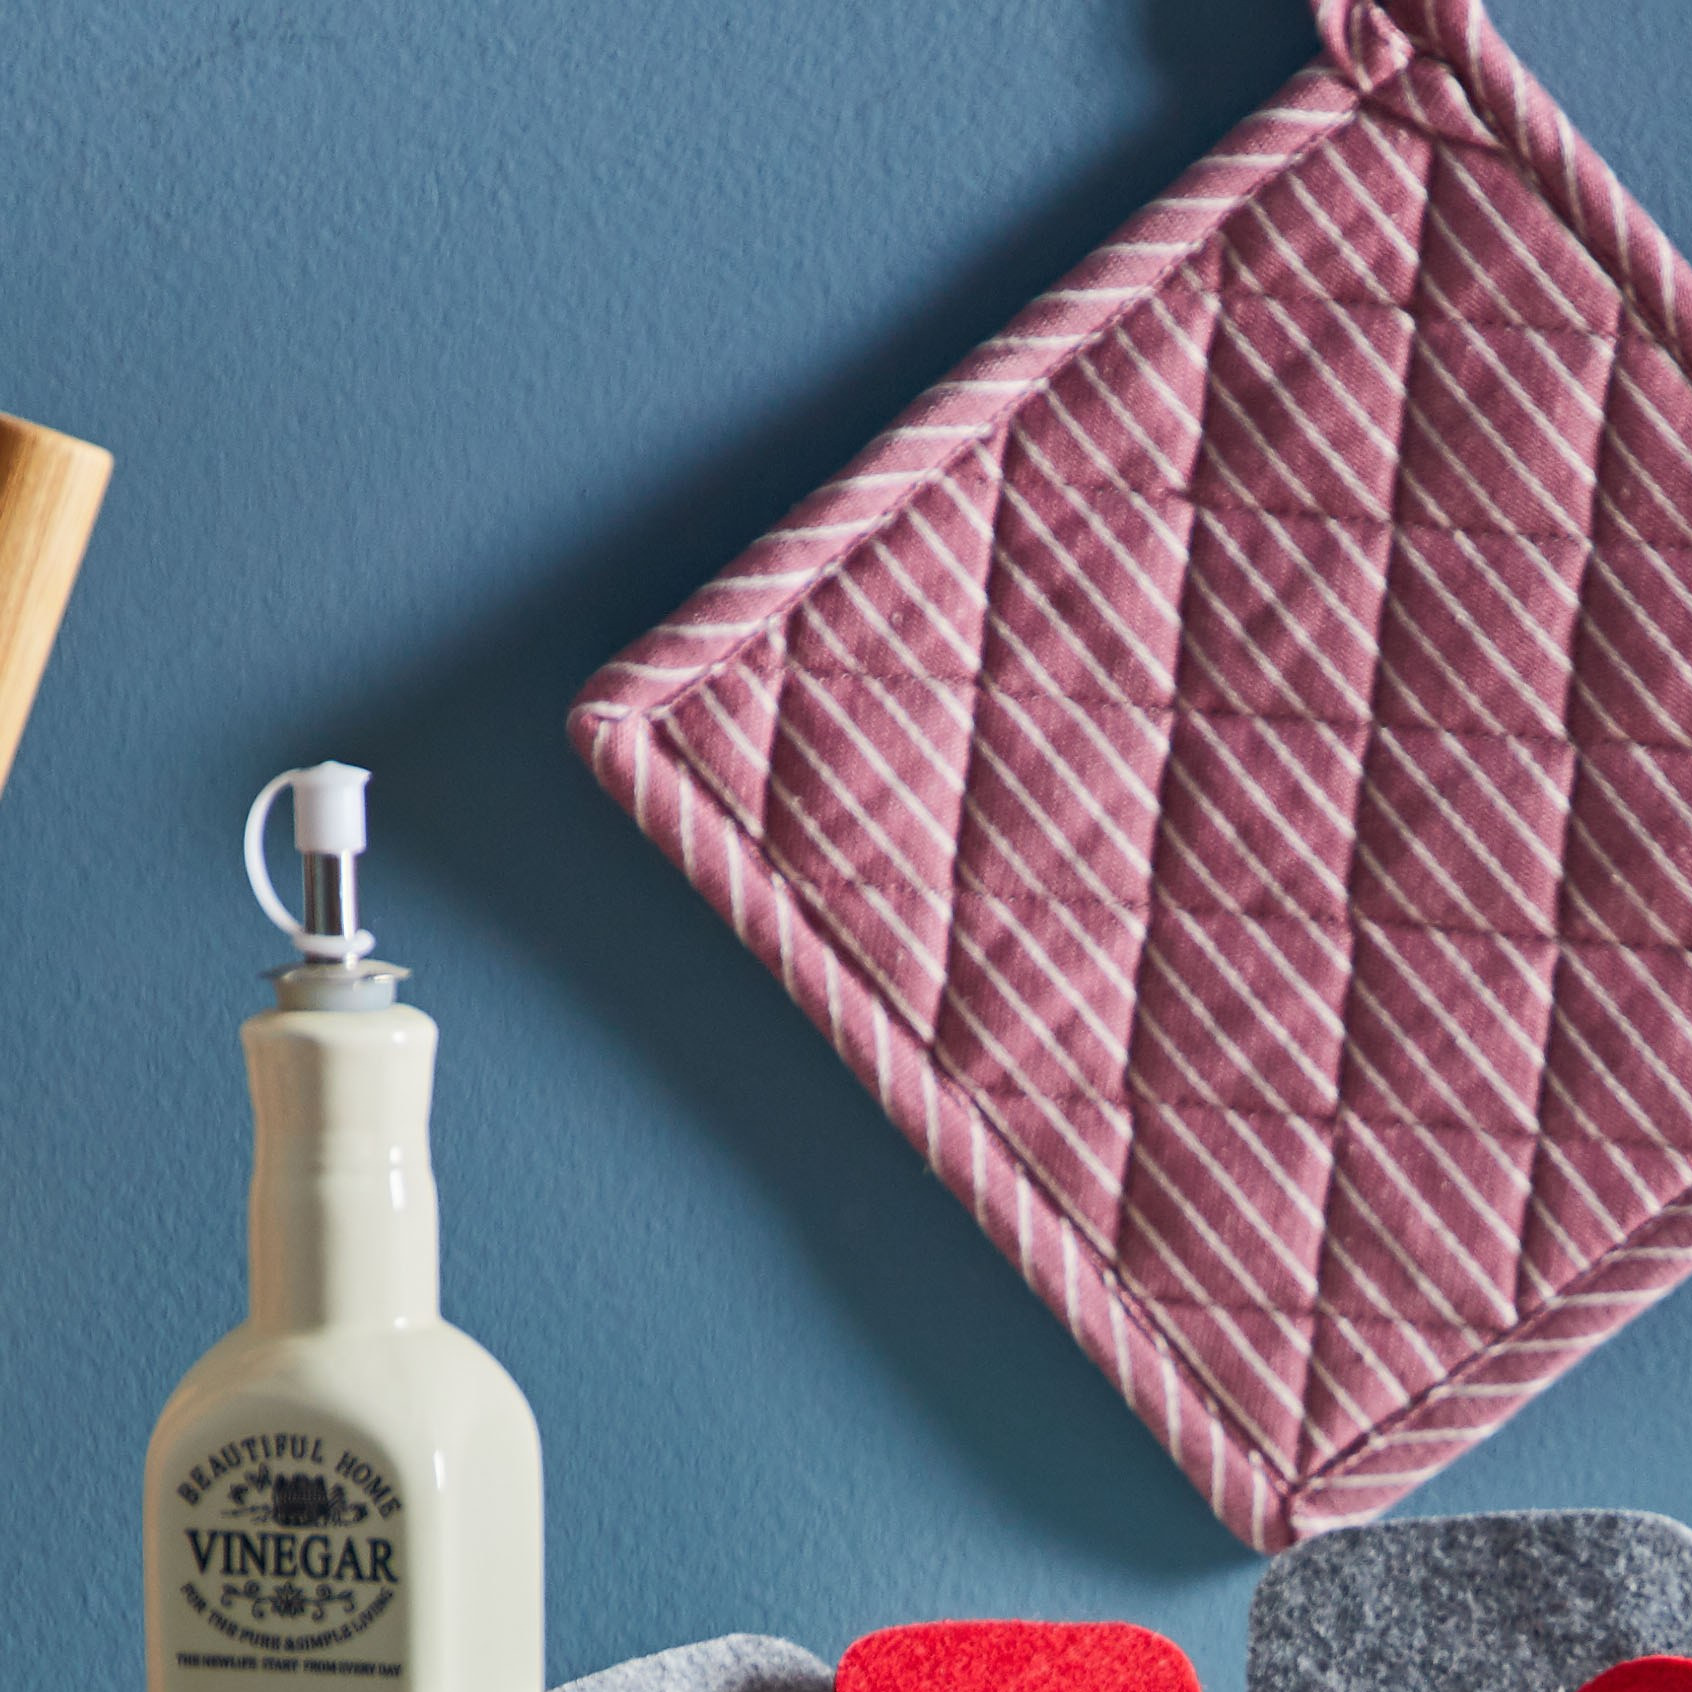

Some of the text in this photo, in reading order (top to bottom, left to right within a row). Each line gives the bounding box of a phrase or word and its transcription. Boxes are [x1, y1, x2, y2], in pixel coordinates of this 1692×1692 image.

[178, 1433, 401, 1520] BEAUTIFUL HOME
[185, 1528, 398, 1583] VINEGAR
[180, 1582, 207, 1613] FOR
[209, 1609, 238, 1637] THE
